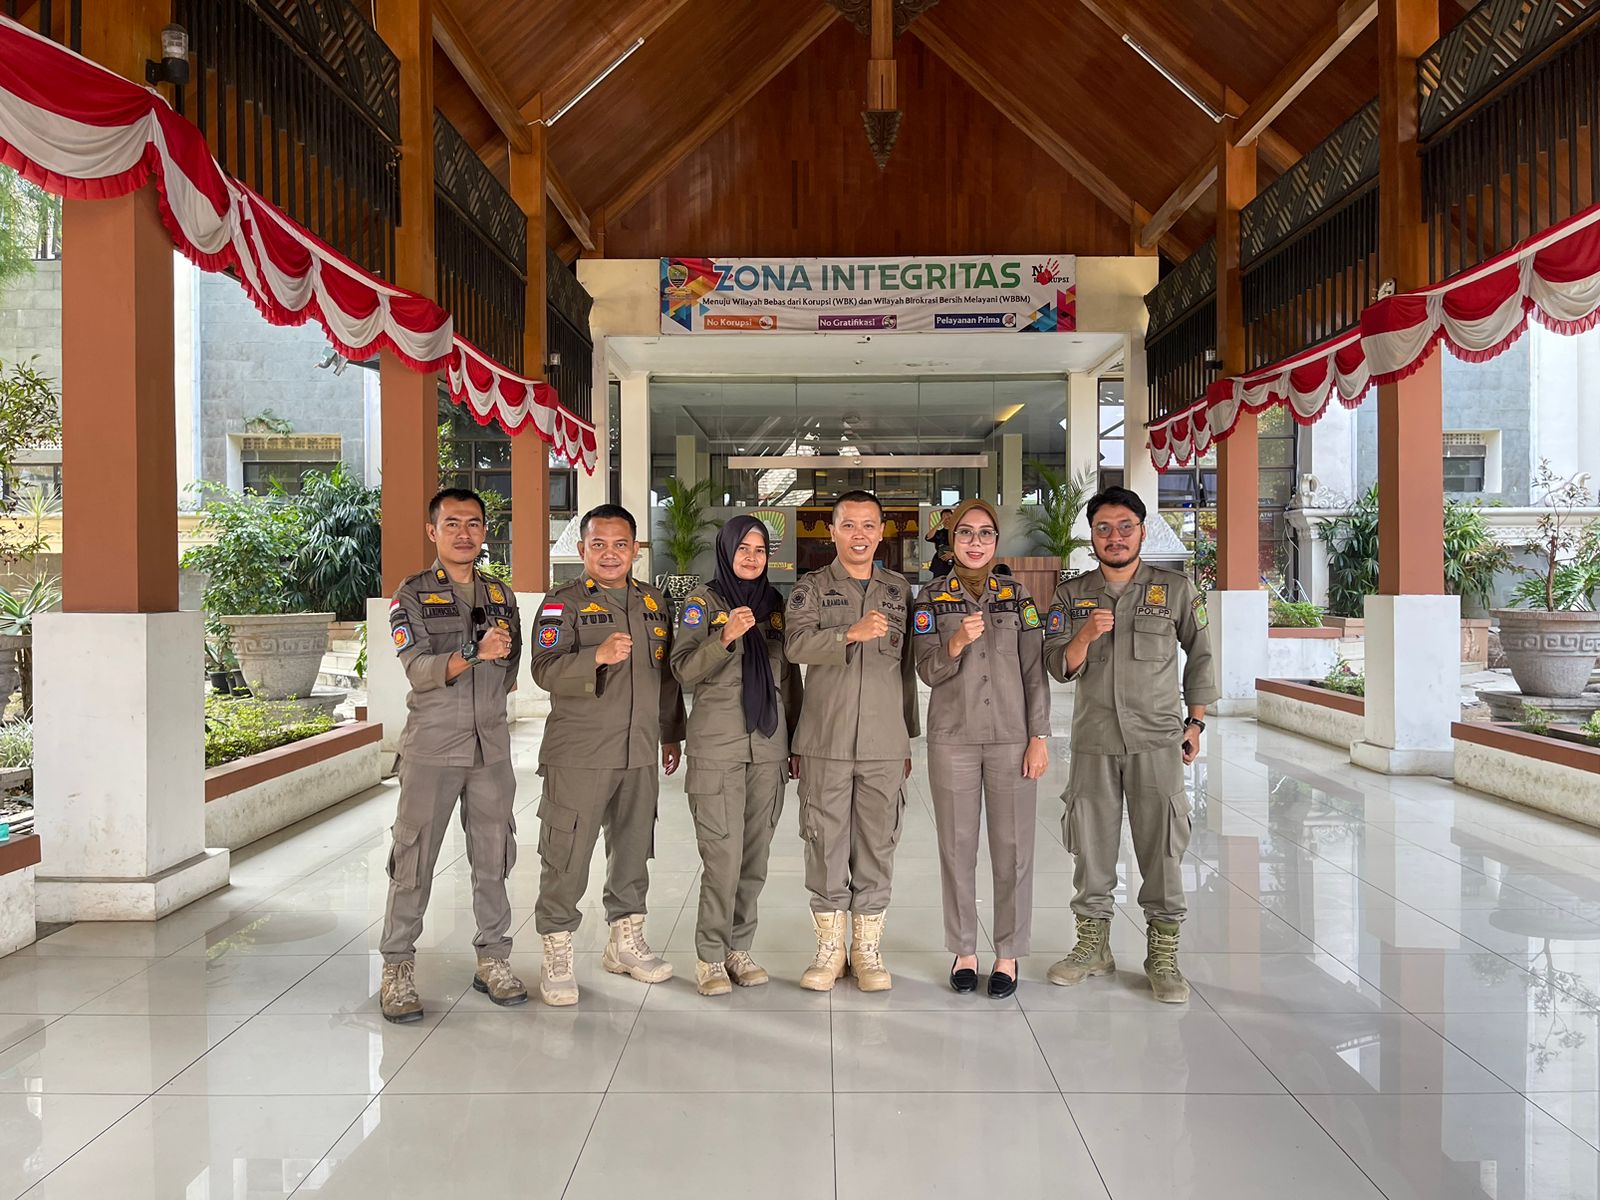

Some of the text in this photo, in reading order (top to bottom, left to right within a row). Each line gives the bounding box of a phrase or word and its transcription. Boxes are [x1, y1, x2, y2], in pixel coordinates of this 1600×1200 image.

[713, 262, 1021, 291] ZONA INTEGRITAS
[702, 295, 1031, 307] Menuju Wilayah Bebas dari Korupsi (WBK) dan Wilayah Birokrasi Bersih Melayani (WBBM)
[706, 316, 752, 327] No Korupsi
[819, 315, 876, 327] No Gratifikasi
[936, 315, 1000, 327] Pelayanan Prima
[882, 601, 906, 612] POL-PP
[1138, 607, 1170, 617] POL PP
[580, 613, 615, 625] YUDI
[642, 612, 659, 621] POL
